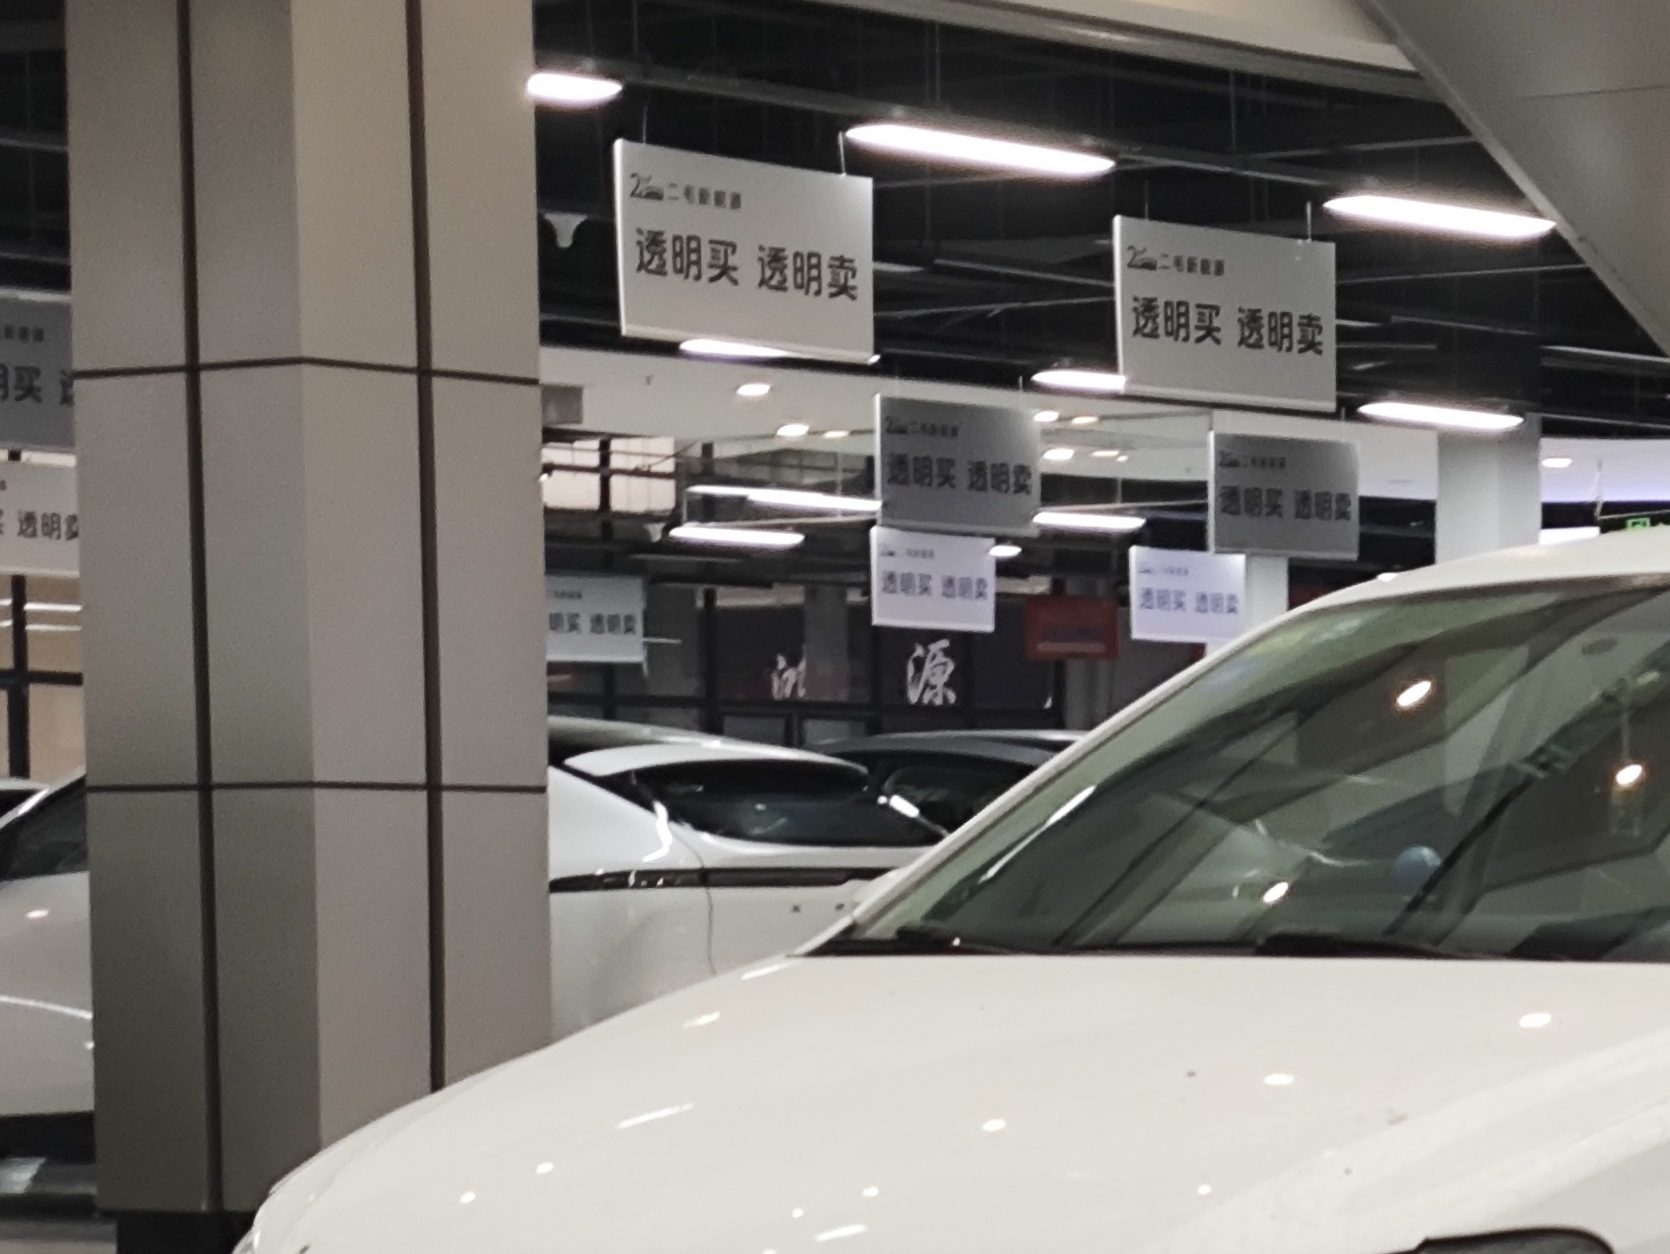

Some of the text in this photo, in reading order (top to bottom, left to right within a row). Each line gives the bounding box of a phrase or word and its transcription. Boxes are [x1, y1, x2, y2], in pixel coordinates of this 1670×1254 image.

[635, 227, 858, 300] 透明买 透明卖
[1132, 296, 1323, 356] 透明买 透明卖
[0, 363, 42, 403] 买
